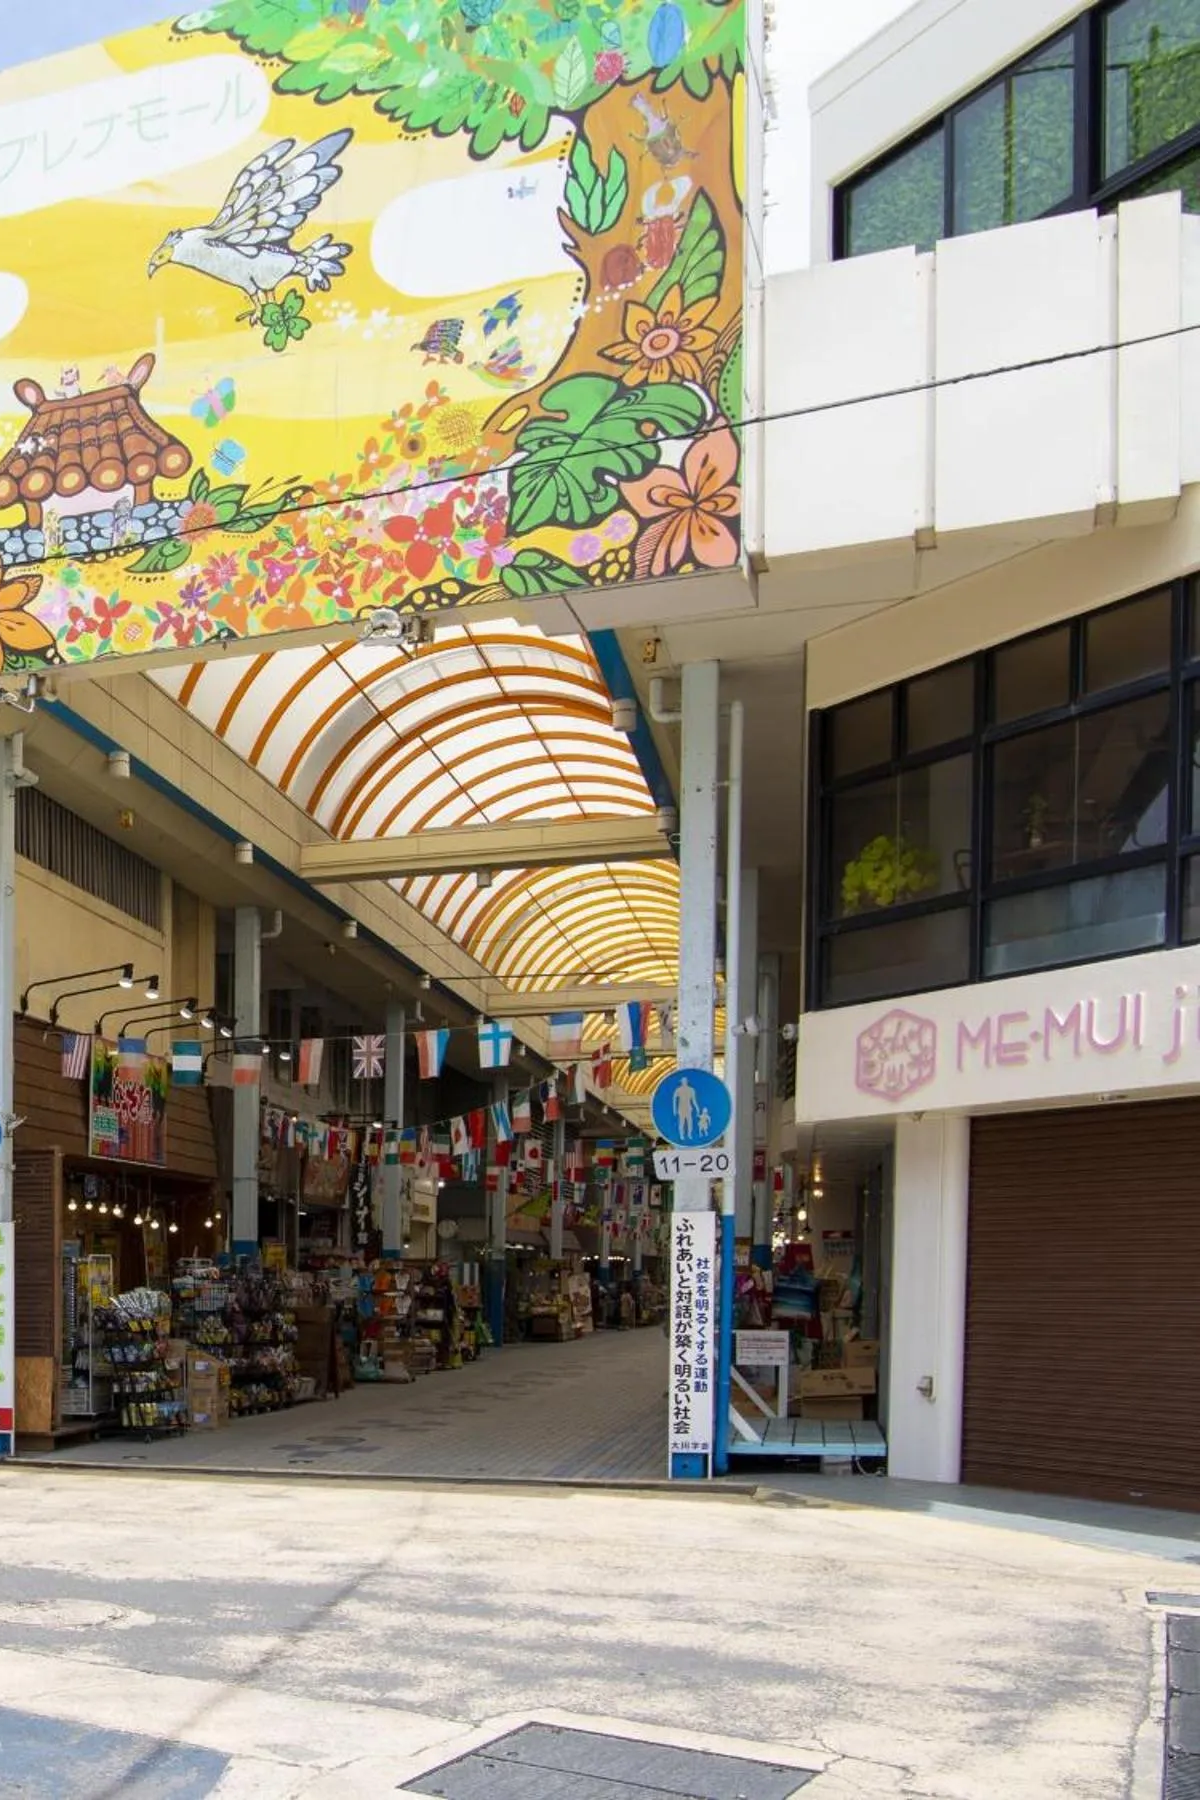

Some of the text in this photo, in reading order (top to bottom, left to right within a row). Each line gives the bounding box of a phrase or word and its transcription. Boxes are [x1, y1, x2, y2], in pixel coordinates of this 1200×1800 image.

[1162, 984, 1200, 1065] j
[660, 1154, 729, 1173] 11-20
[673, 1218, 694, 1434] ふれあいと対話が築く明るい社会
[694, 1257, 710, 1392] 社会を明るくする運動
